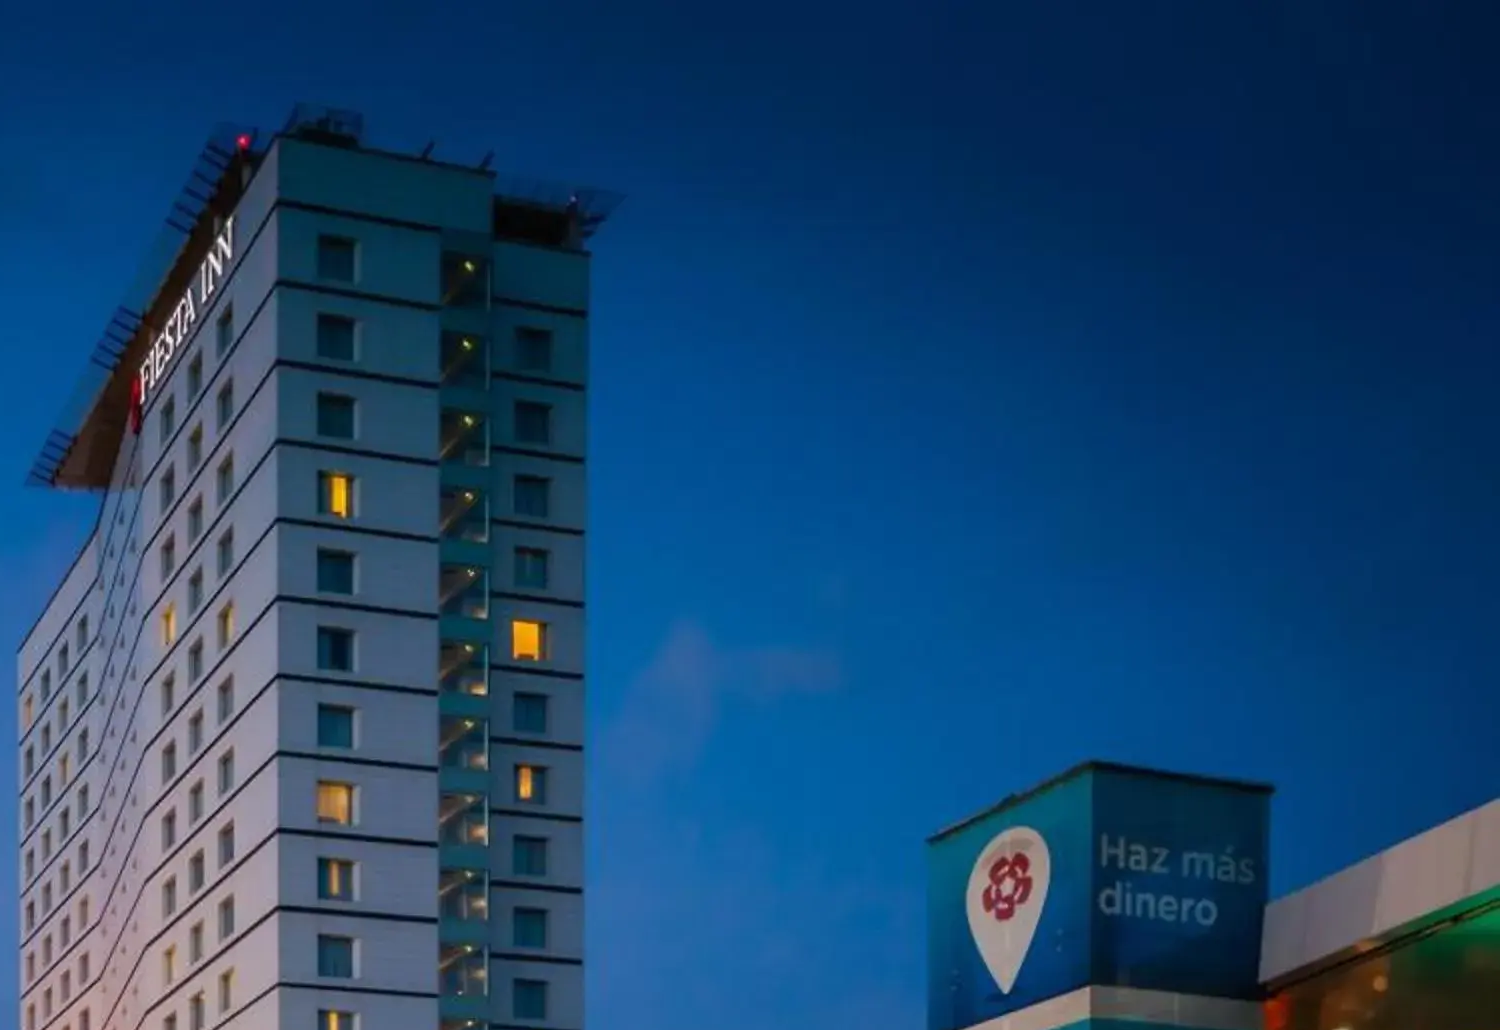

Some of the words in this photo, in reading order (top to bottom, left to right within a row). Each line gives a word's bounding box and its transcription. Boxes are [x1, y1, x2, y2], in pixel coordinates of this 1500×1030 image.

[140, 287, 196, 405] FIESTA
[201, 214, 234, 304] INN
[1100, 832, 1170, 874] Haz
[1182, 844, 1255, 884] más
[1099, 880, 1218, 926] dinero
